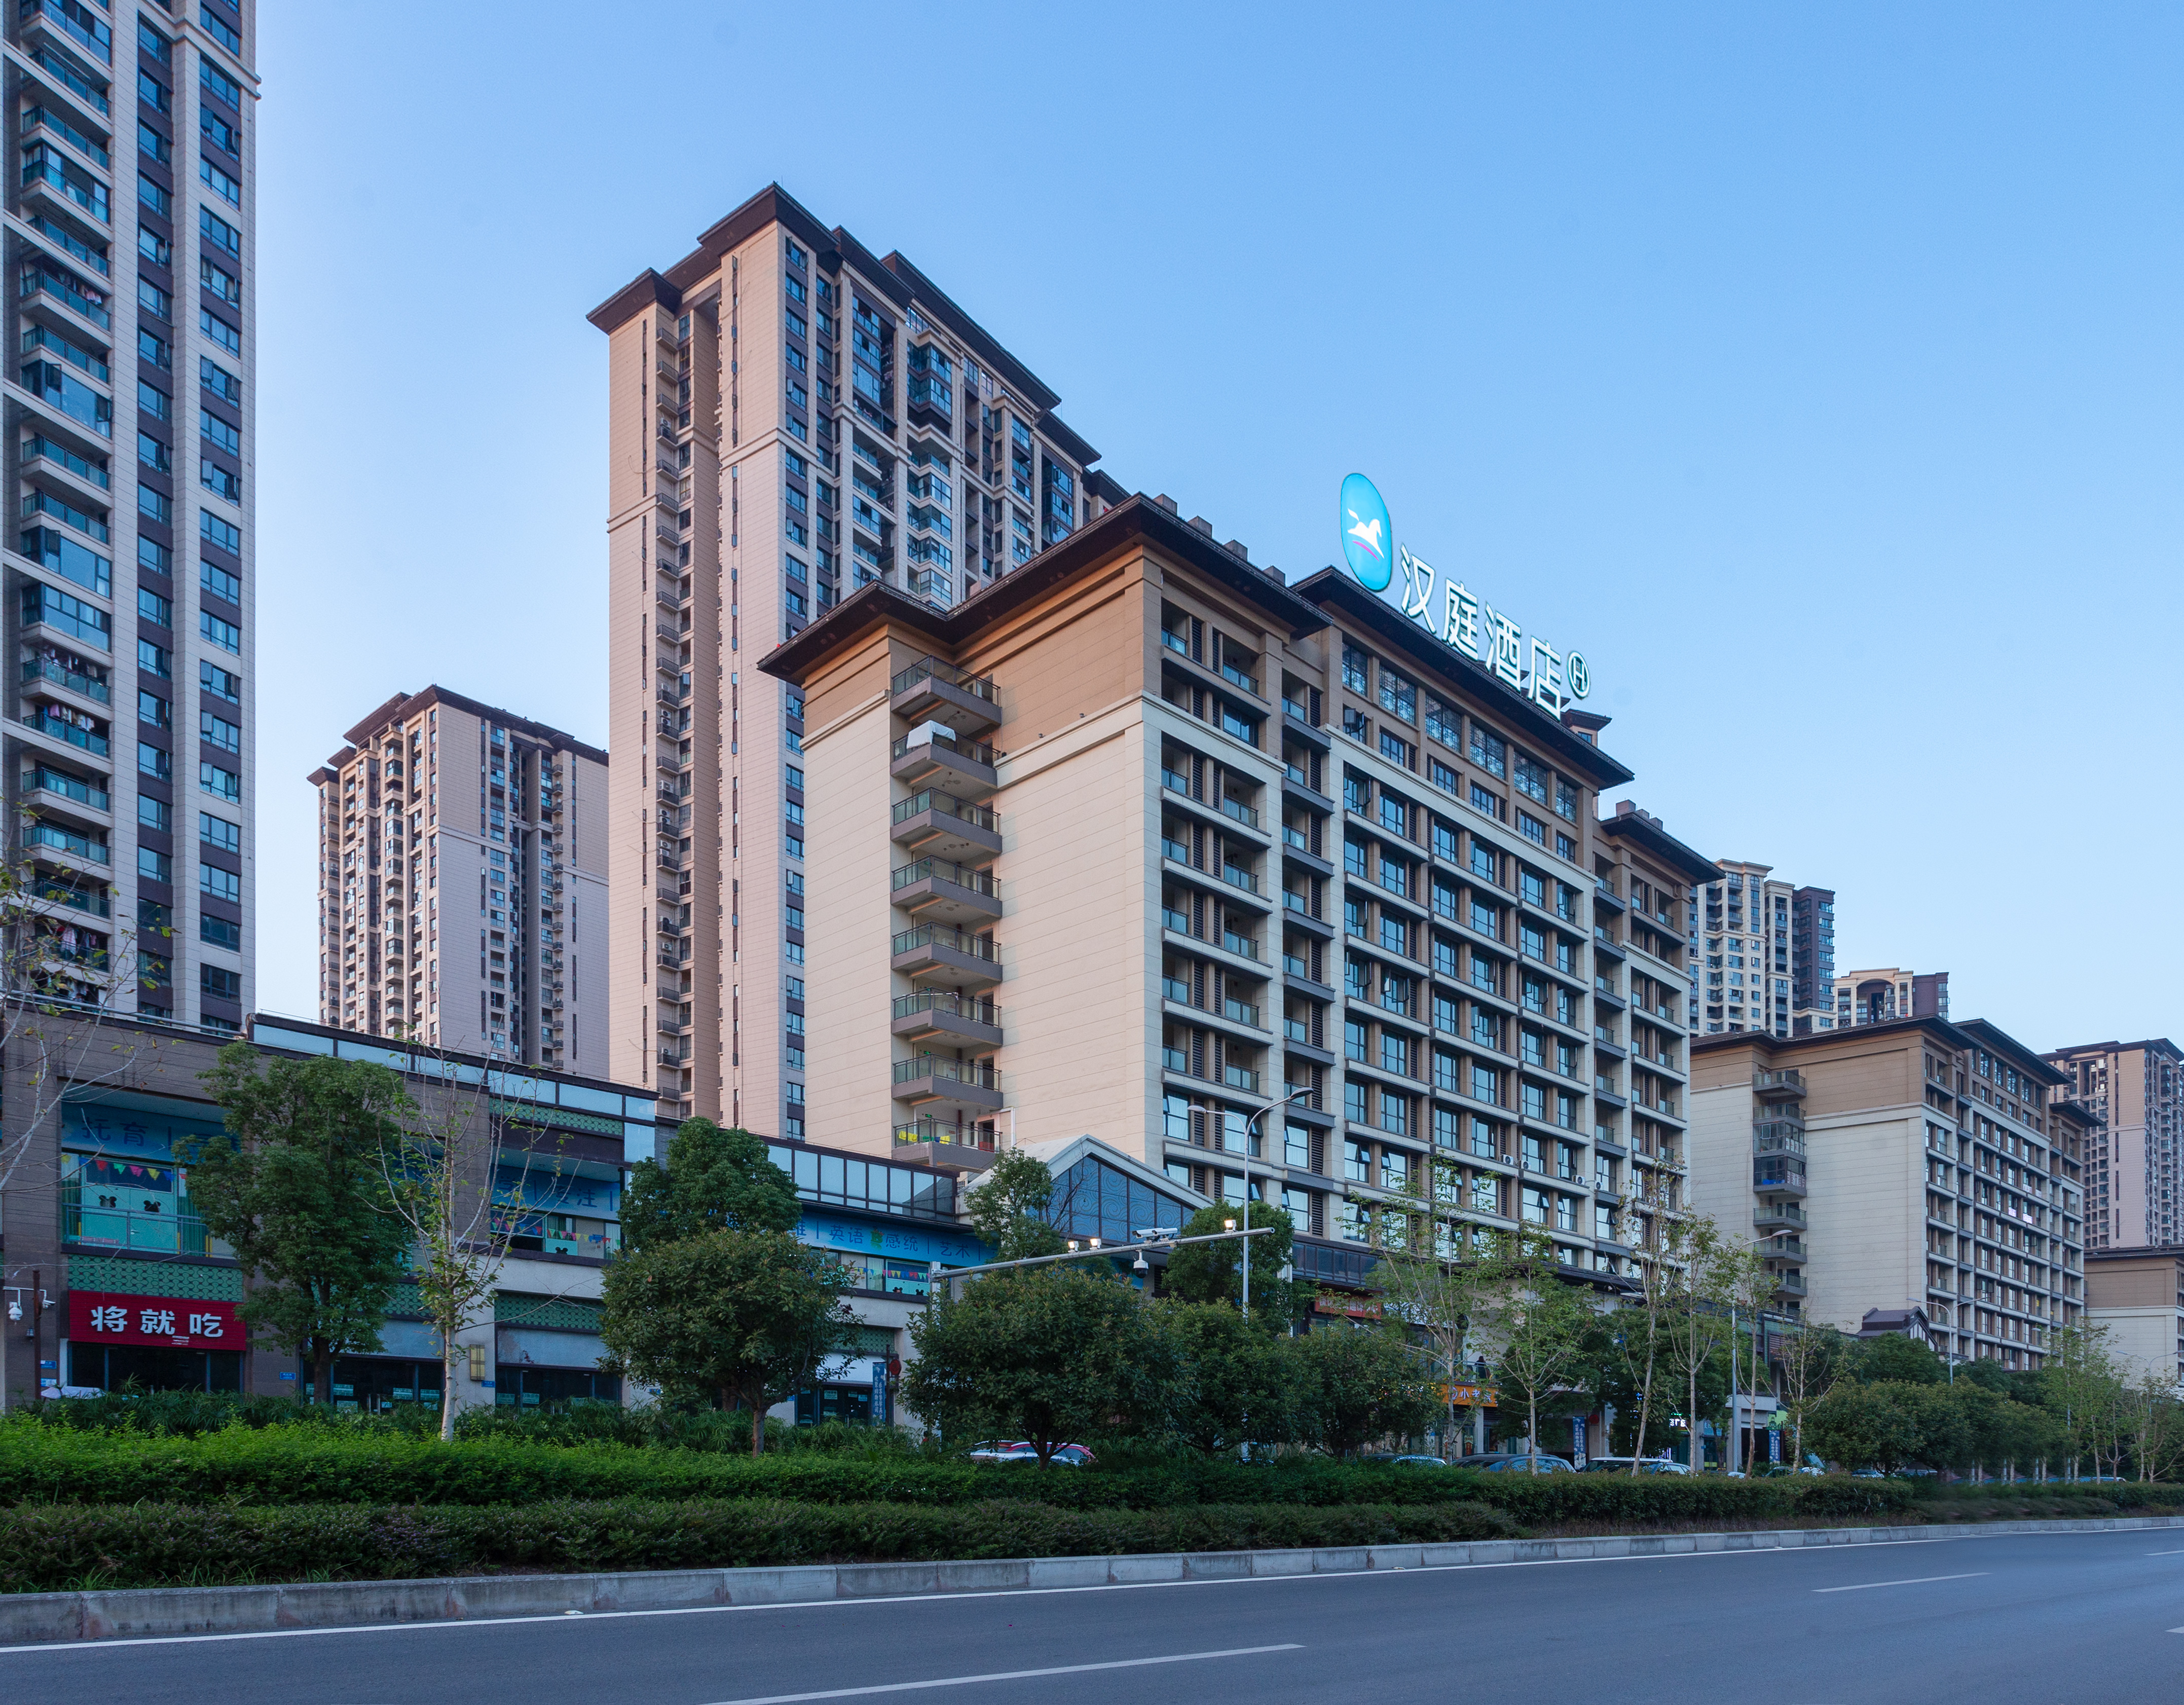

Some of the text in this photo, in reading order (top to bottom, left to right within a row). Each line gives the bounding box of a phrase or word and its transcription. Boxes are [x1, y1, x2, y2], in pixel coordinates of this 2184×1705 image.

[1400, 543, 1561, 723] 汉庭酒店
[81, 1117, 149, 1146] 托育
[829, 1225, 864, 1248] 英语
[885, 1234, 919, 1252] 感统
[939, 1241, 971, 1258] 艺术
[91, 1306, 223, 1338] 将就吃
